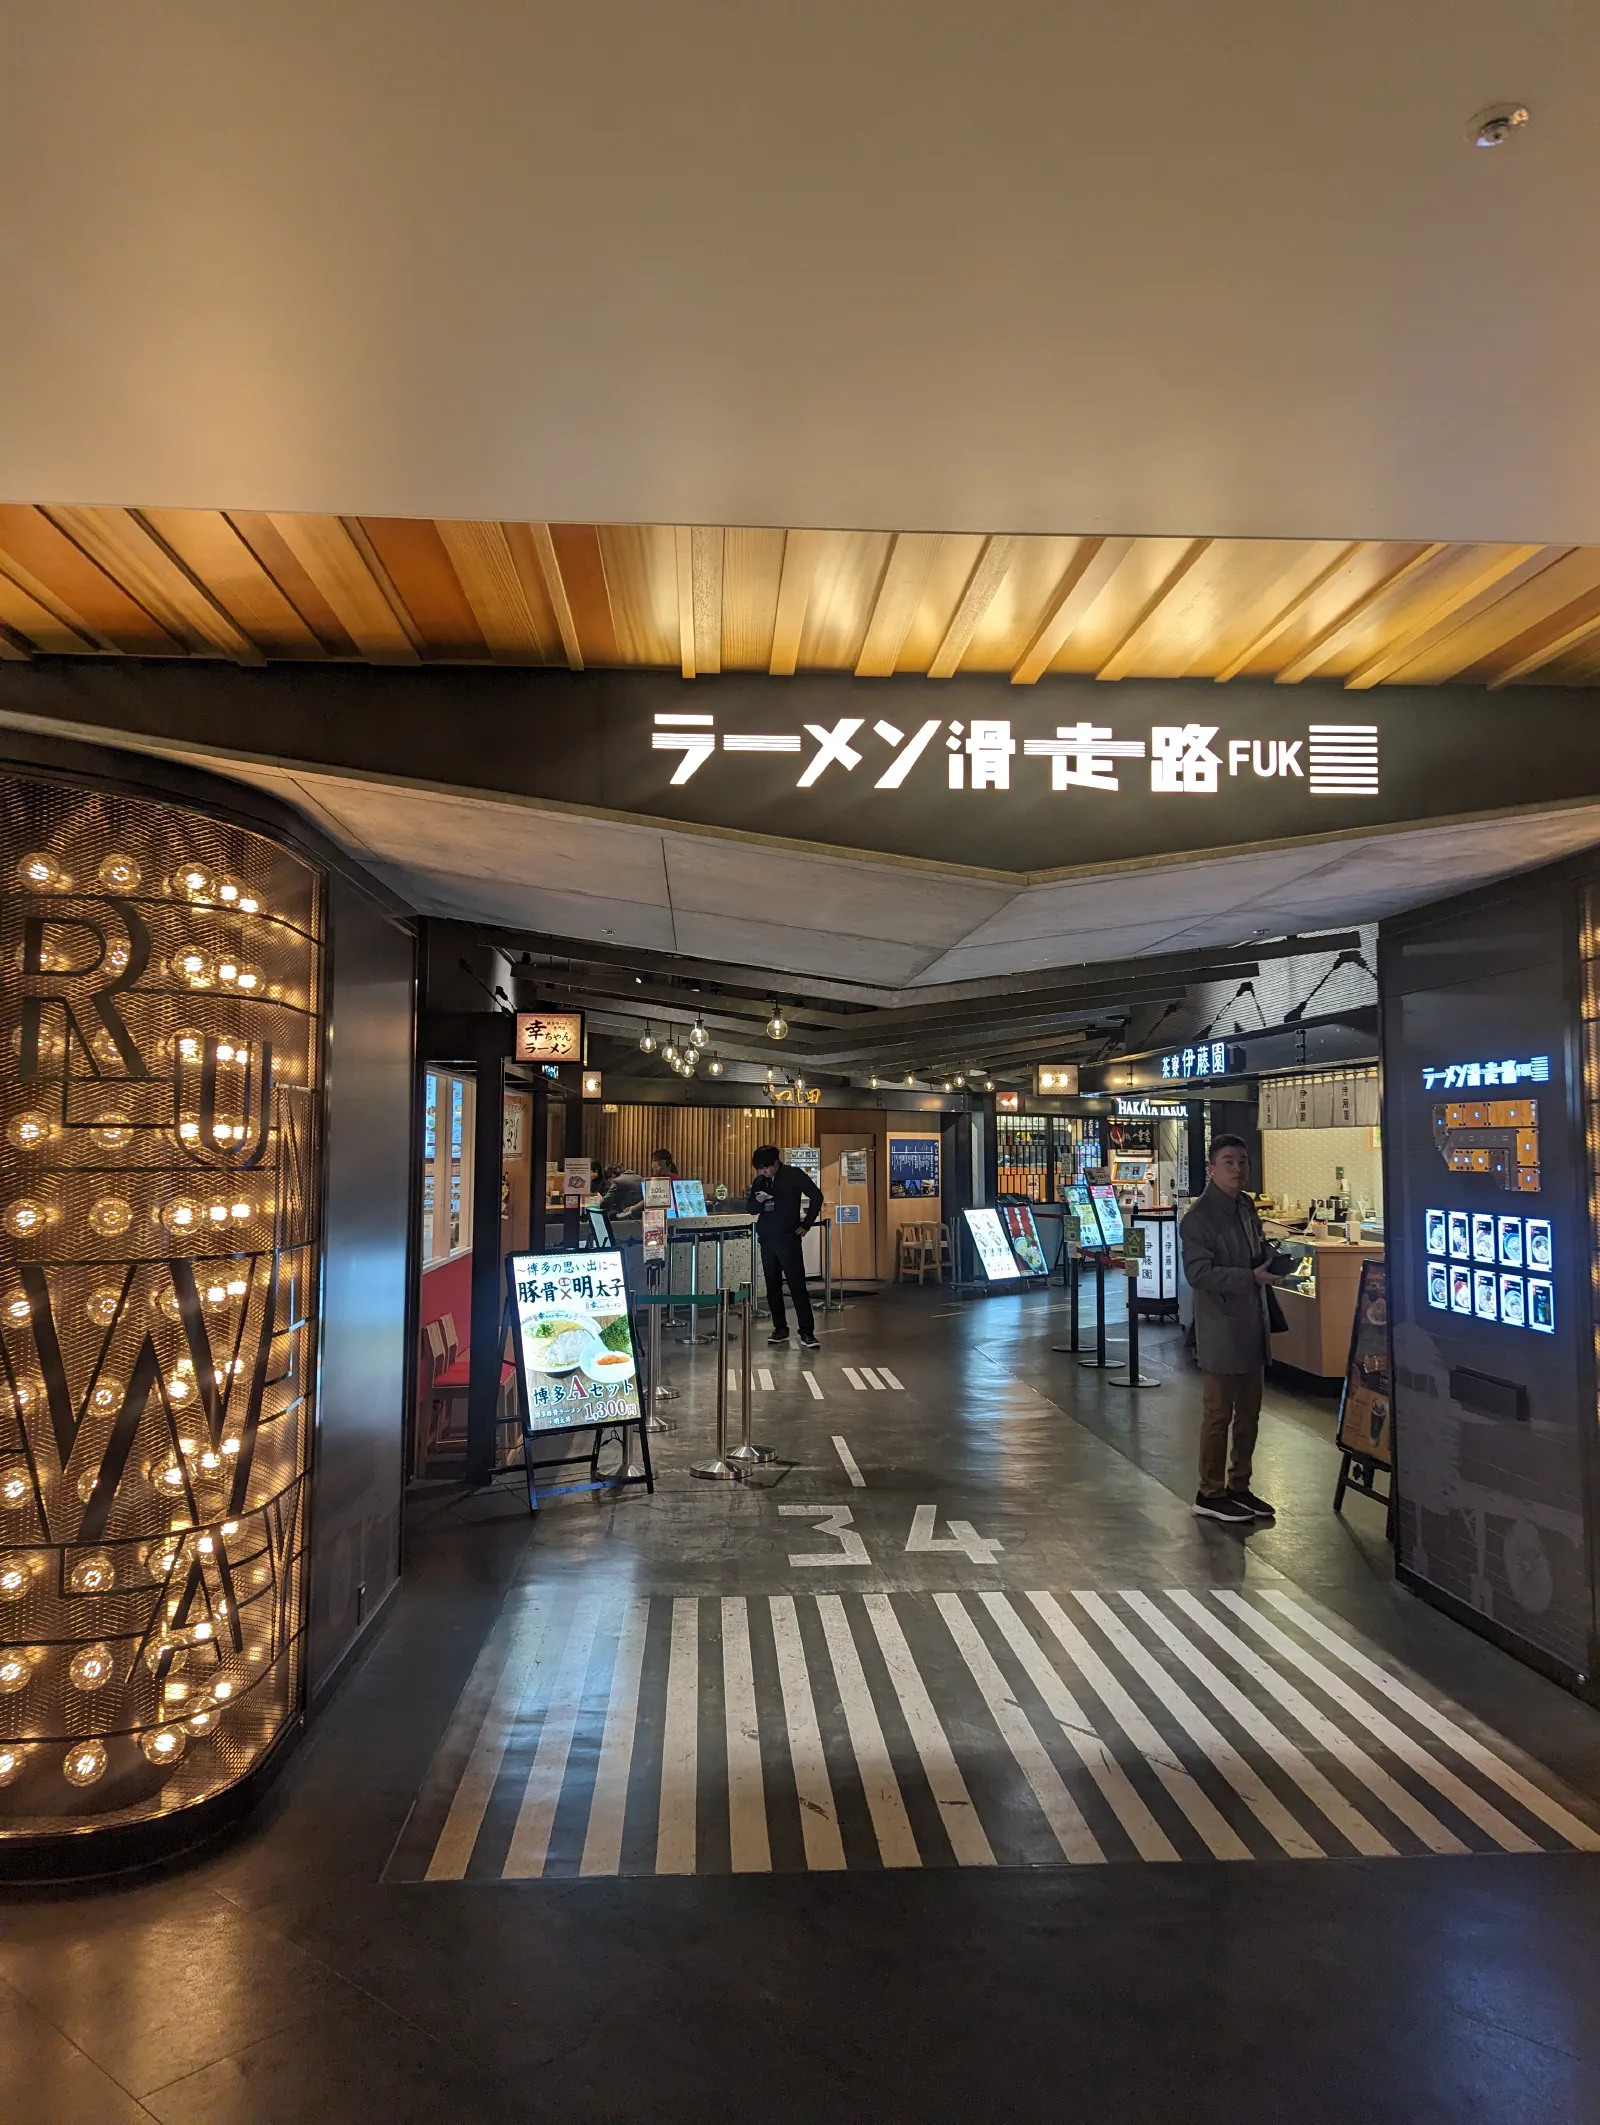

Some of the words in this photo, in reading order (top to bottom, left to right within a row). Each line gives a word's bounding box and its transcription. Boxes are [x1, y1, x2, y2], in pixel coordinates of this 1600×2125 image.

[651, 713, 1223, 793] ラーメン滑走路
[1228, 739, 1305, 778] FUK
[524, 1019, 573, 1042] 幸ちゃん
[524, 1042, 573, 1055] ラーメン
[1182, 1042, 1225, 1078] 伊藤園
[533, 1374, 634, 1406] 博多Aセット
[584, 1399, 638, 1421] 1,300円
